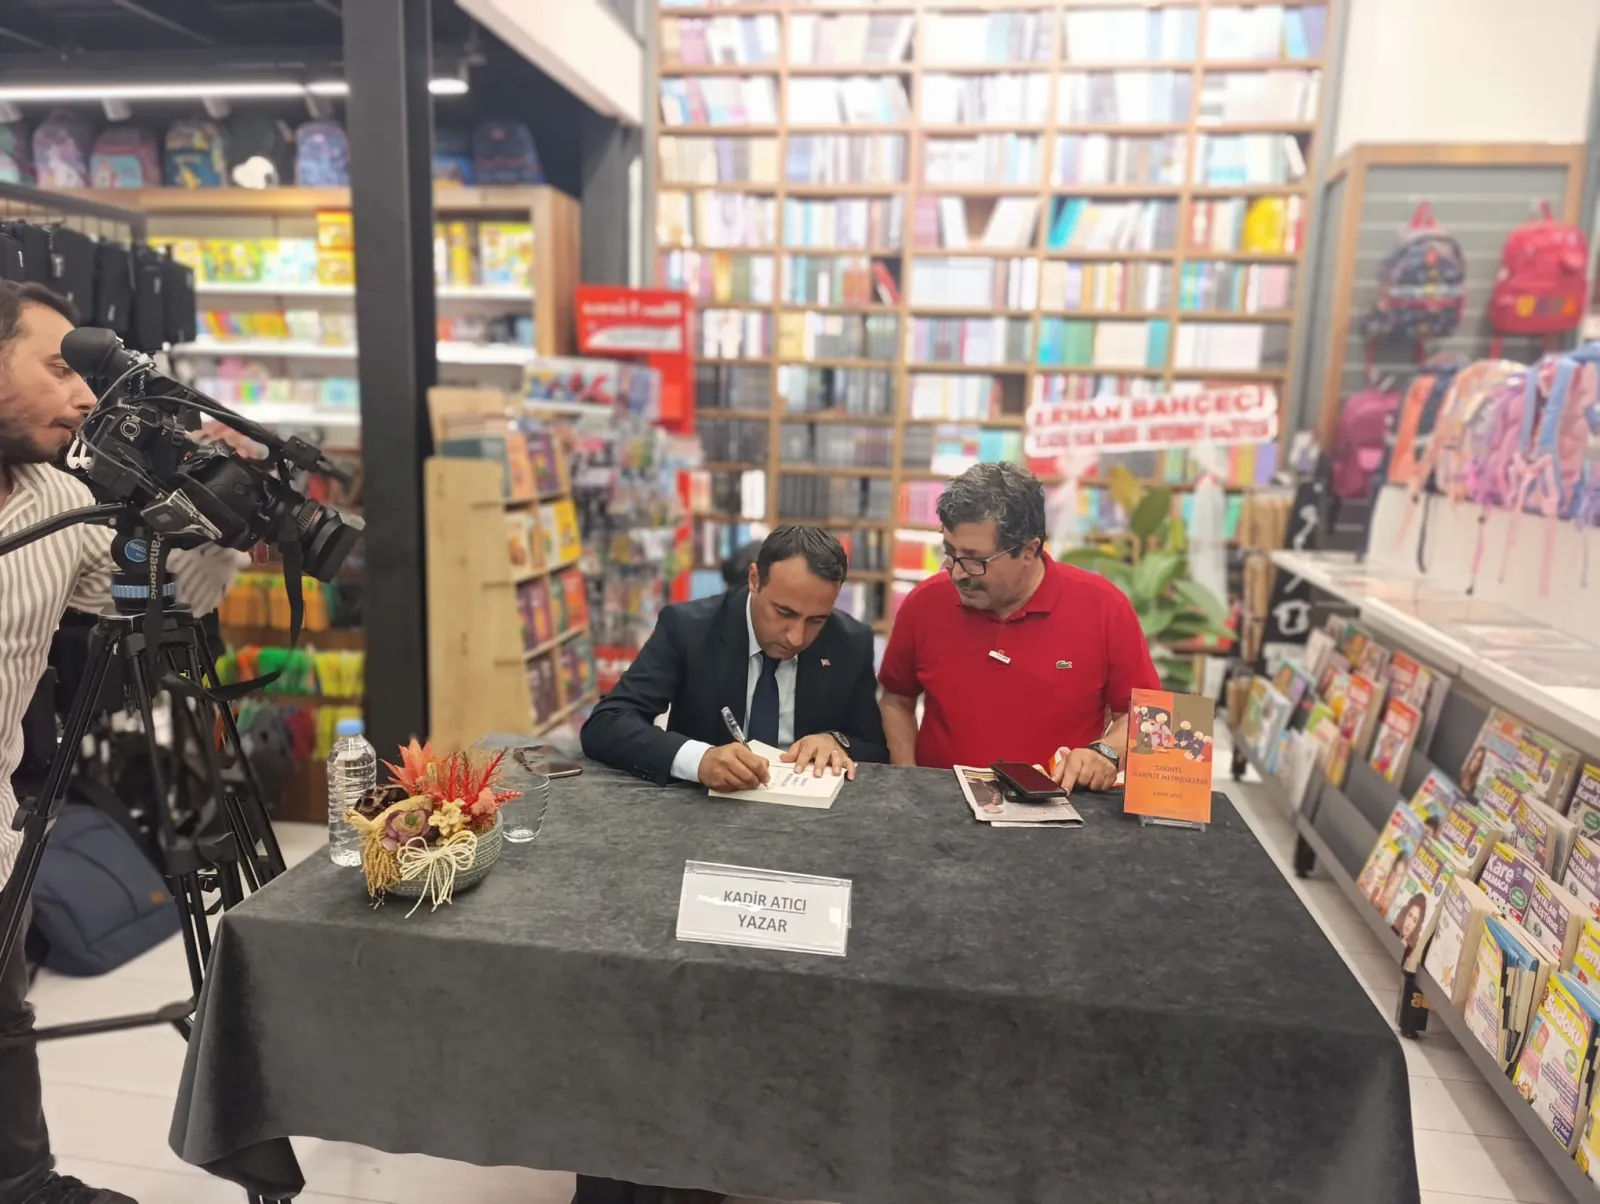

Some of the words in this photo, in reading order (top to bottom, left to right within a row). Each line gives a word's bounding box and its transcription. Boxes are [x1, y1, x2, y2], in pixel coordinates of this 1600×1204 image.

[149, 531, 165, 600] Panasonic
[1485, 853, 1515, 883] Kare
[723, 889, 766, 907] KADİR
[770, 896, 807, 912] ATICI
[738, 914, 788, 933] YAZAR
[1544, 993, 1584, 1049] Sudoku
